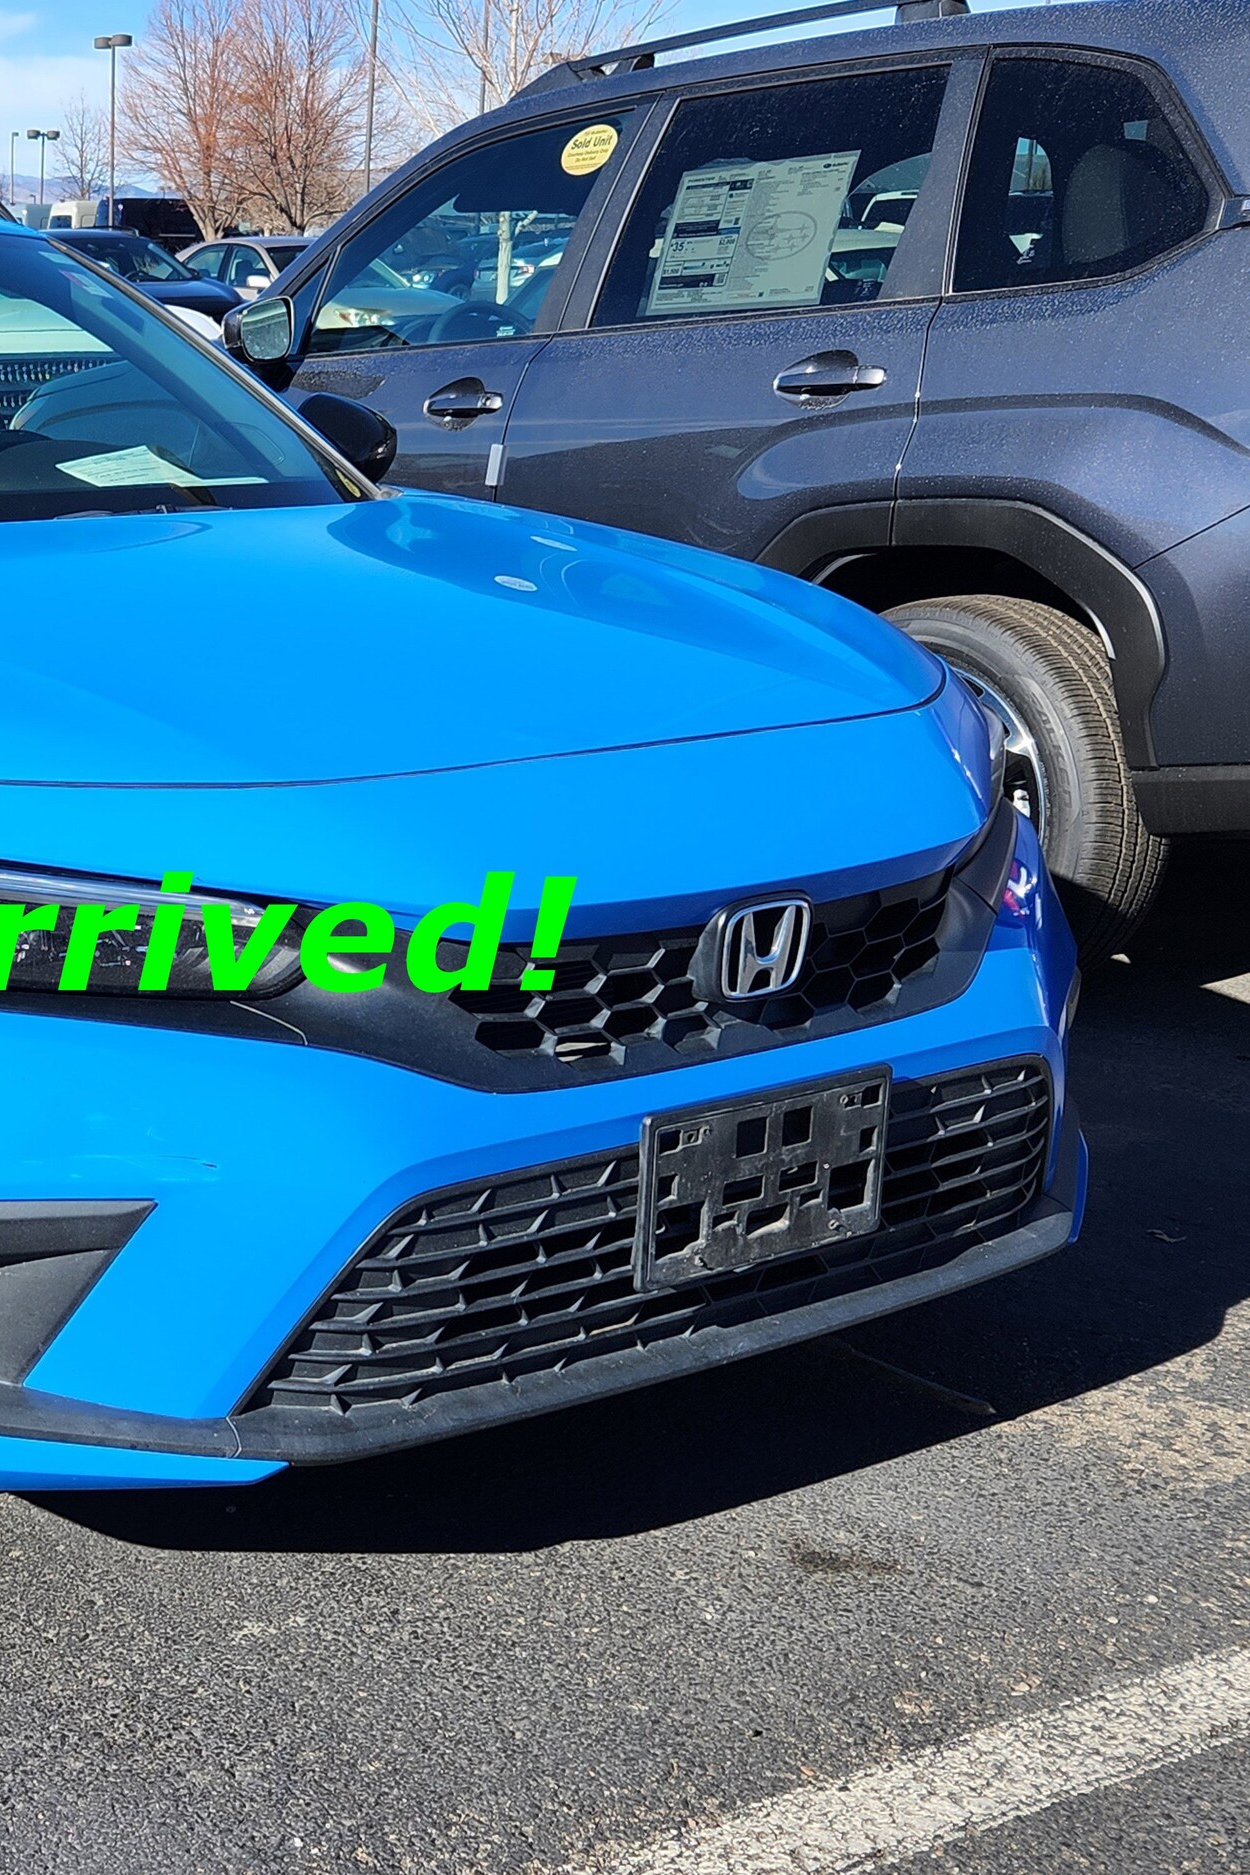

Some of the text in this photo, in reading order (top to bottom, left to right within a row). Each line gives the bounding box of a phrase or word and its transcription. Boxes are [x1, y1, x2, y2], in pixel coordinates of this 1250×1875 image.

[571, 135, 613, 150] Sold Unit
[672, 241, 685, 253] 35
